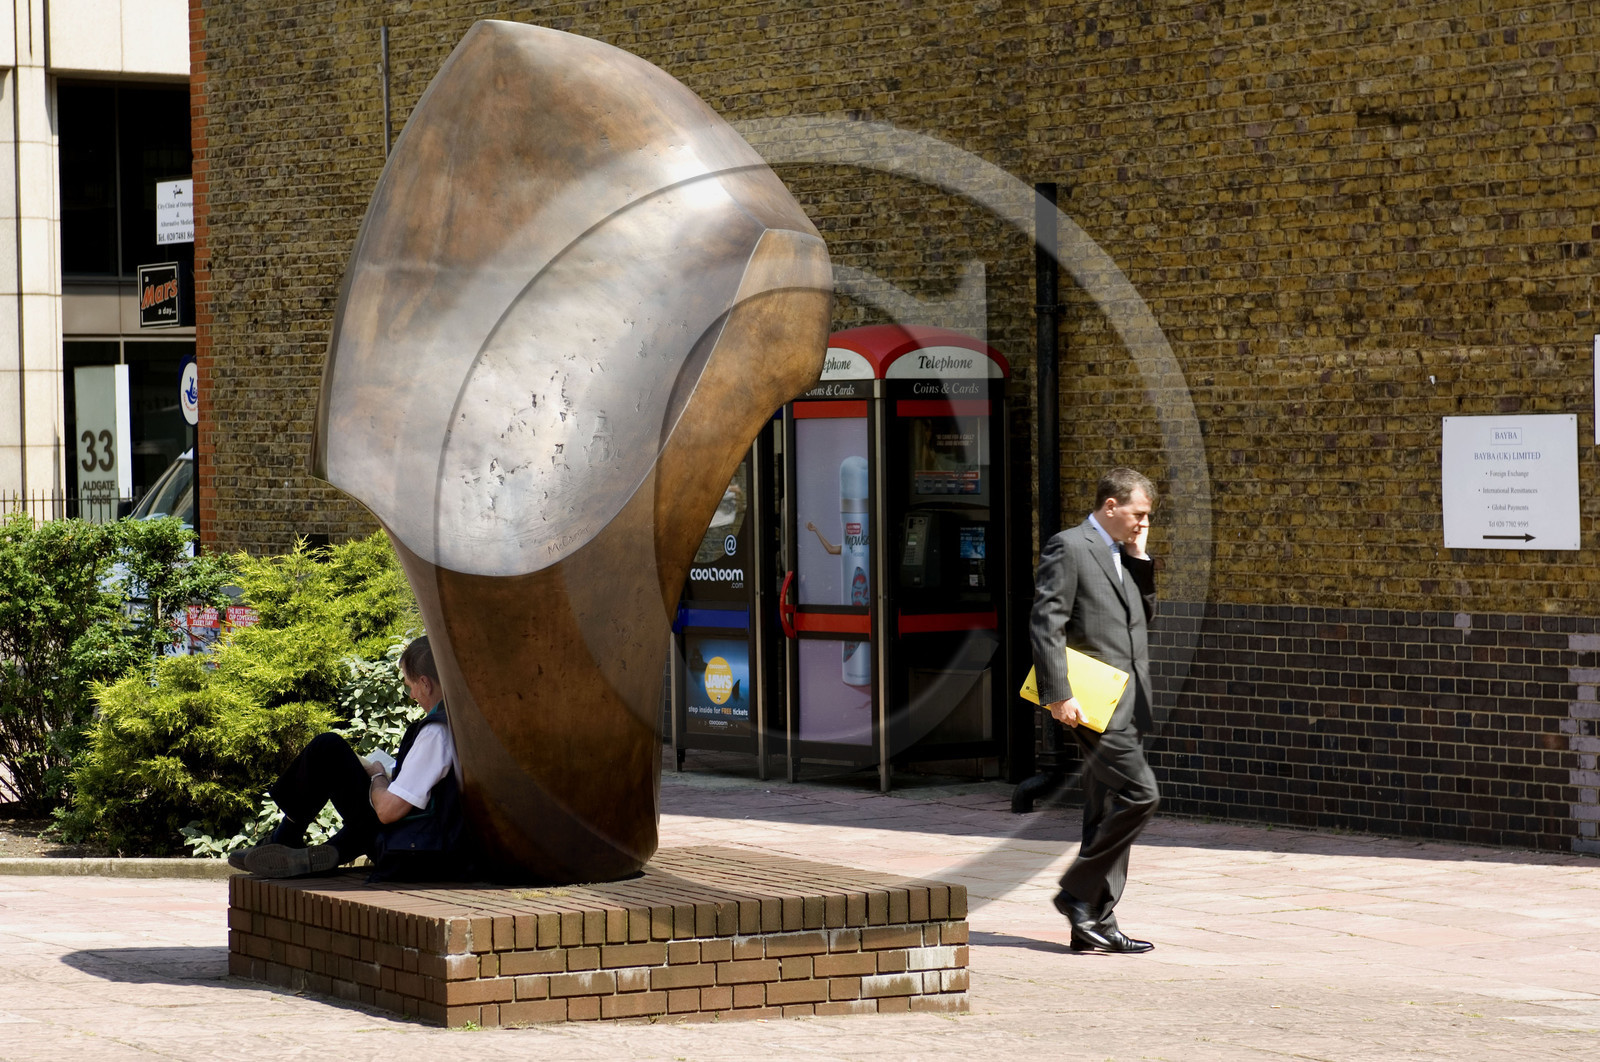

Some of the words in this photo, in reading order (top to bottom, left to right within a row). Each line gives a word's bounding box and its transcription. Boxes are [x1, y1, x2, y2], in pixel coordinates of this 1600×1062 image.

[141, 279, 178, 310] Mars
[918, 355, 973, 371] Telephone
[826, 385, 833, 396] &
[834, 384, 855, 396] Cards
[913, 383, 940, 394] Coins
[941, 383, 949, 394] &
[952, 383, 979, 394] Cards
[81, 429, 114, 472] 33
[1474, 452, 1495, 460] BAYBA
[1497, 452, 1511, 461] (UK)
[1512, 452, 1541, 460] LIMITED
[1490, 470, 1506, 478] Foreign
[1507, 470, 1529, 478] Exchange
[83, 480, 115, 491] ALDGATE
[1508, 504, 1529, 512] Payments
[706, 674, 732, 689] JAWS
[688, 706, 698, 714] step
[699, 706, 713, 714] inside
[733, 708, 748, 716] tickets
